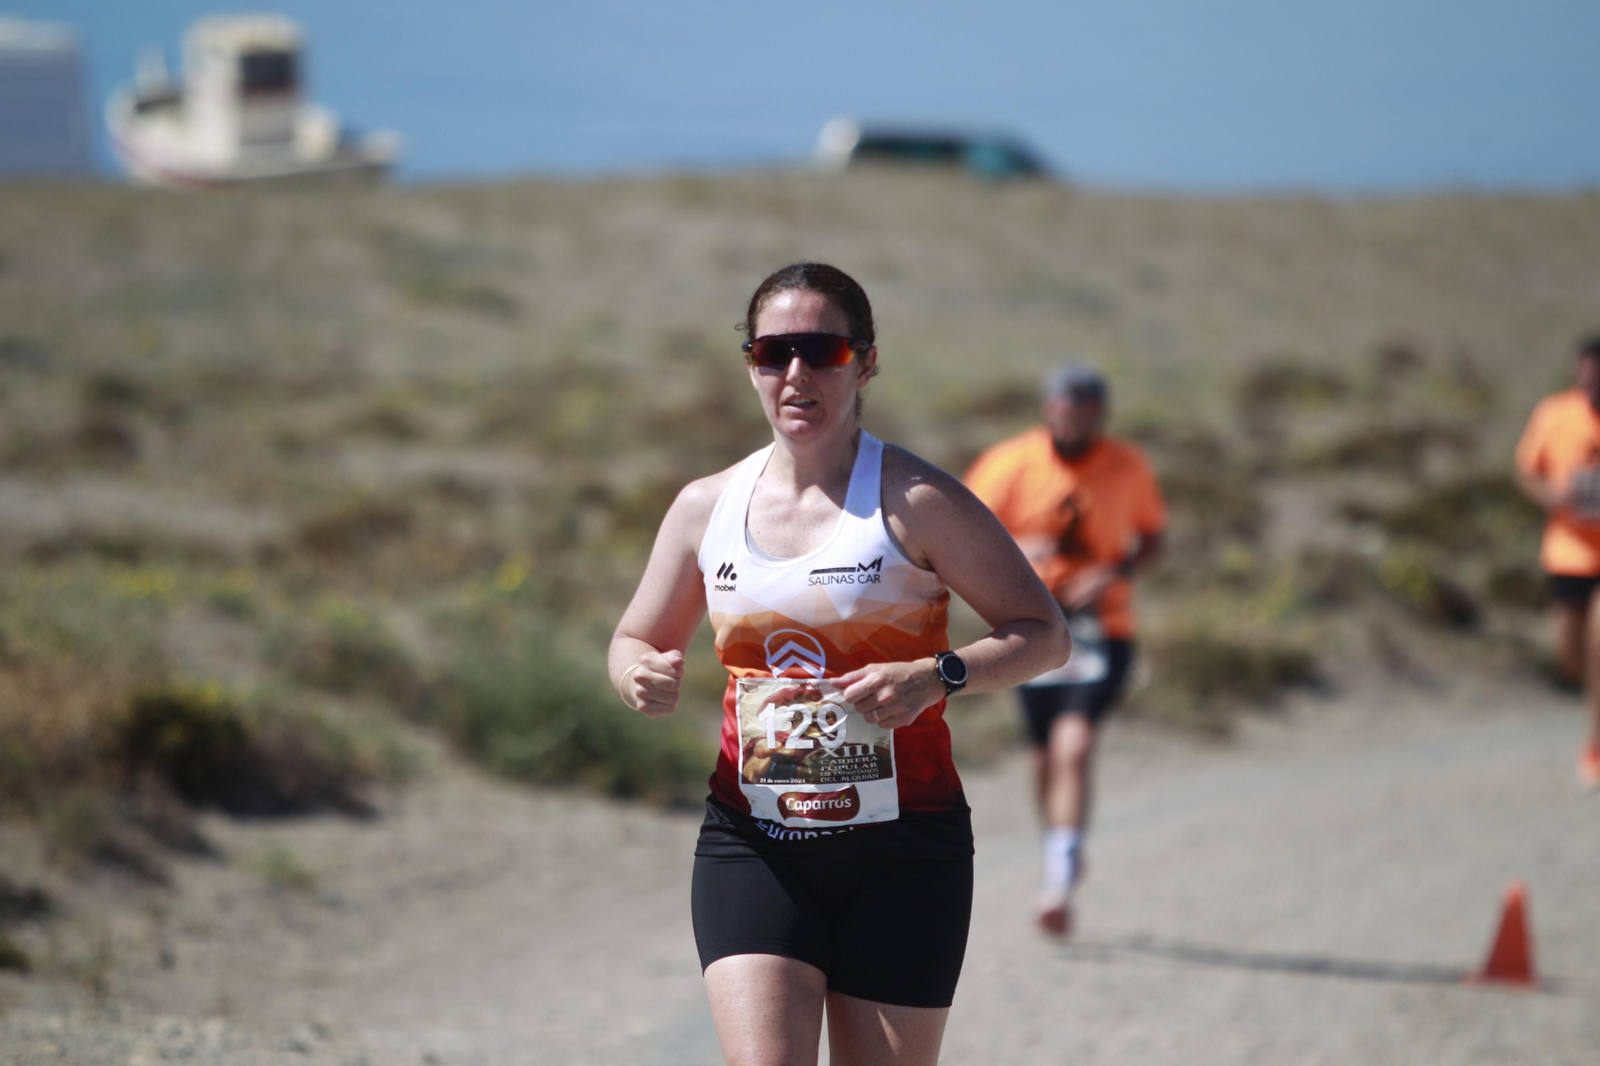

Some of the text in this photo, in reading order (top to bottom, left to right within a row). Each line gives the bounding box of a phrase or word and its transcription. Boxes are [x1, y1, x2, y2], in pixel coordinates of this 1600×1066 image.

[808, 574, 881, 586] SALINAS CAR
[715, 584, 736, 592] mobel
[758, 702, 848, 750] 129
[820, 744, 877, 758] XIII
[820, 756, 878, 765] CARRERA
[820, 763, 878, 772] POPULAR
